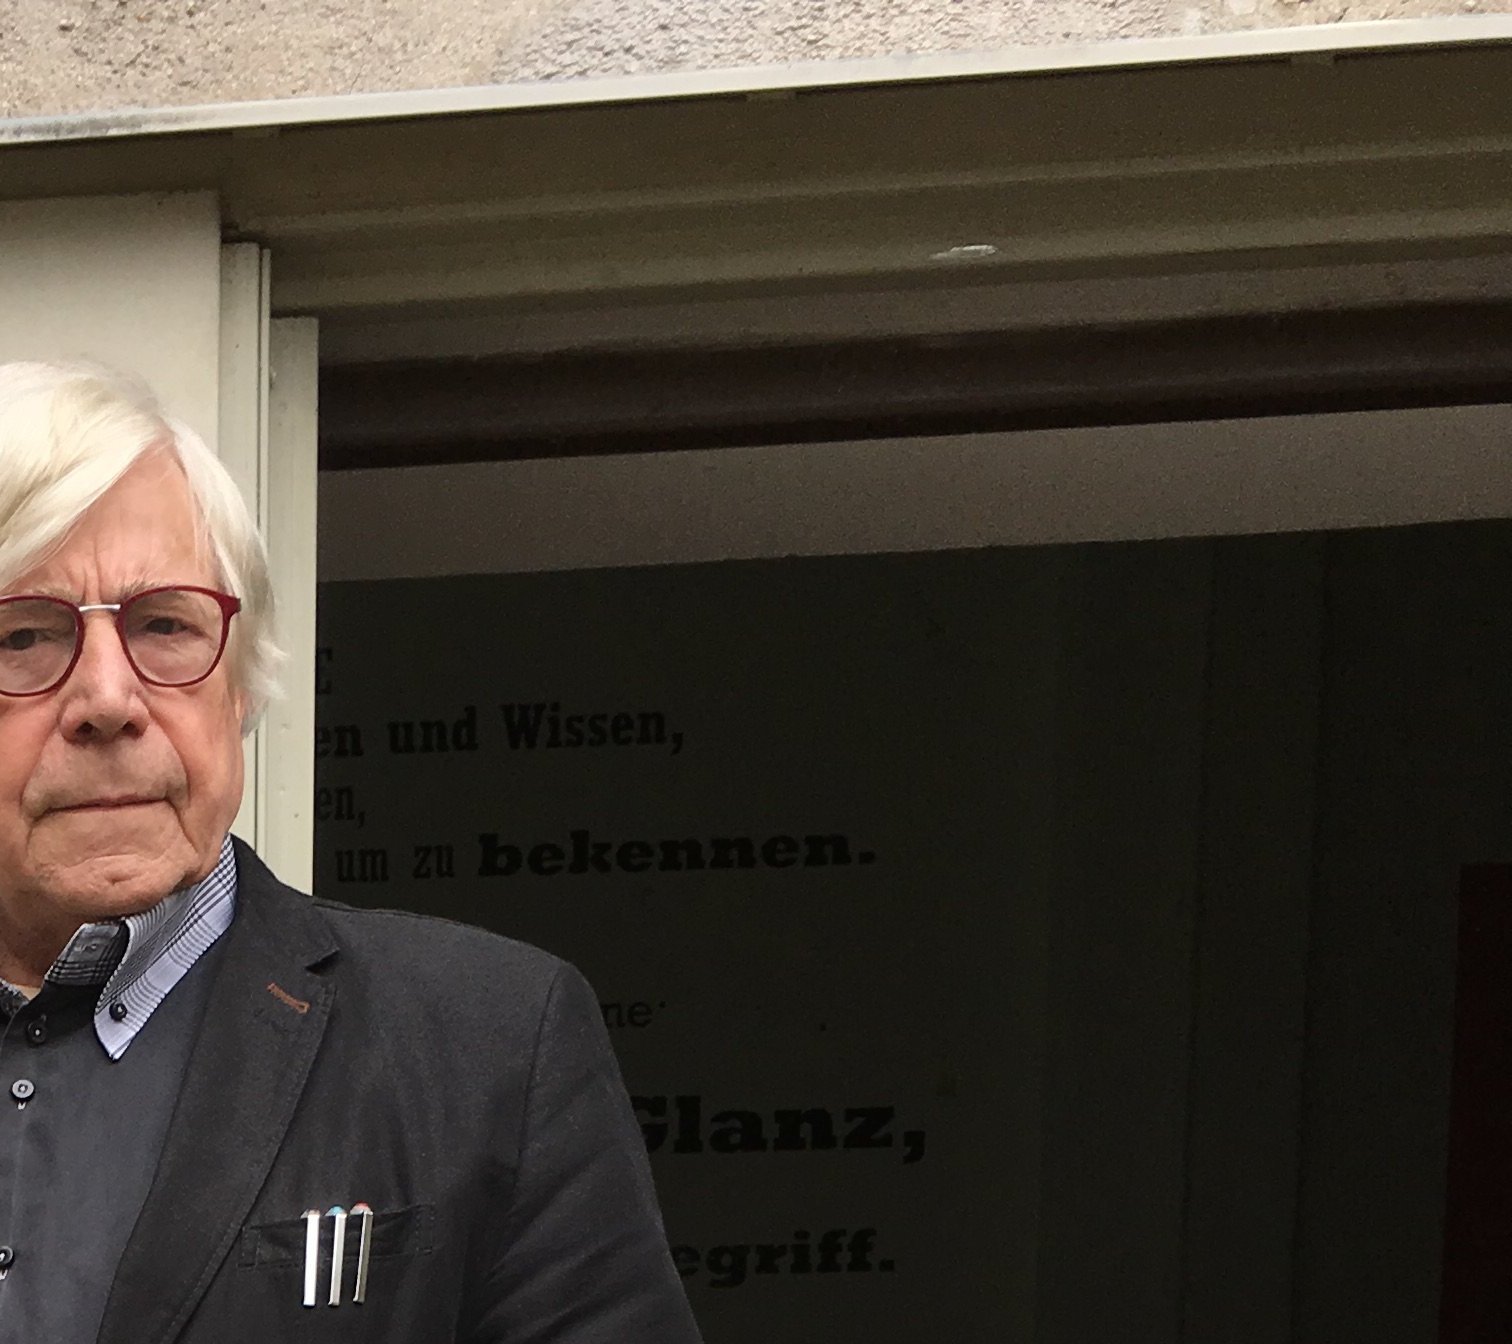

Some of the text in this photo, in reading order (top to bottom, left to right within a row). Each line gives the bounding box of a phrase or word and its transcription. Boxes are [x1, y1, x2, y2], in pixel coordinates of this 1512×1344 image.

[388, 706, 478, 754] und
[501, 702, 684, 755] Wissen,
[334, 829, 878, 883] um zu bekennen.
[631, 1095, 926, 1164] Glanz,
